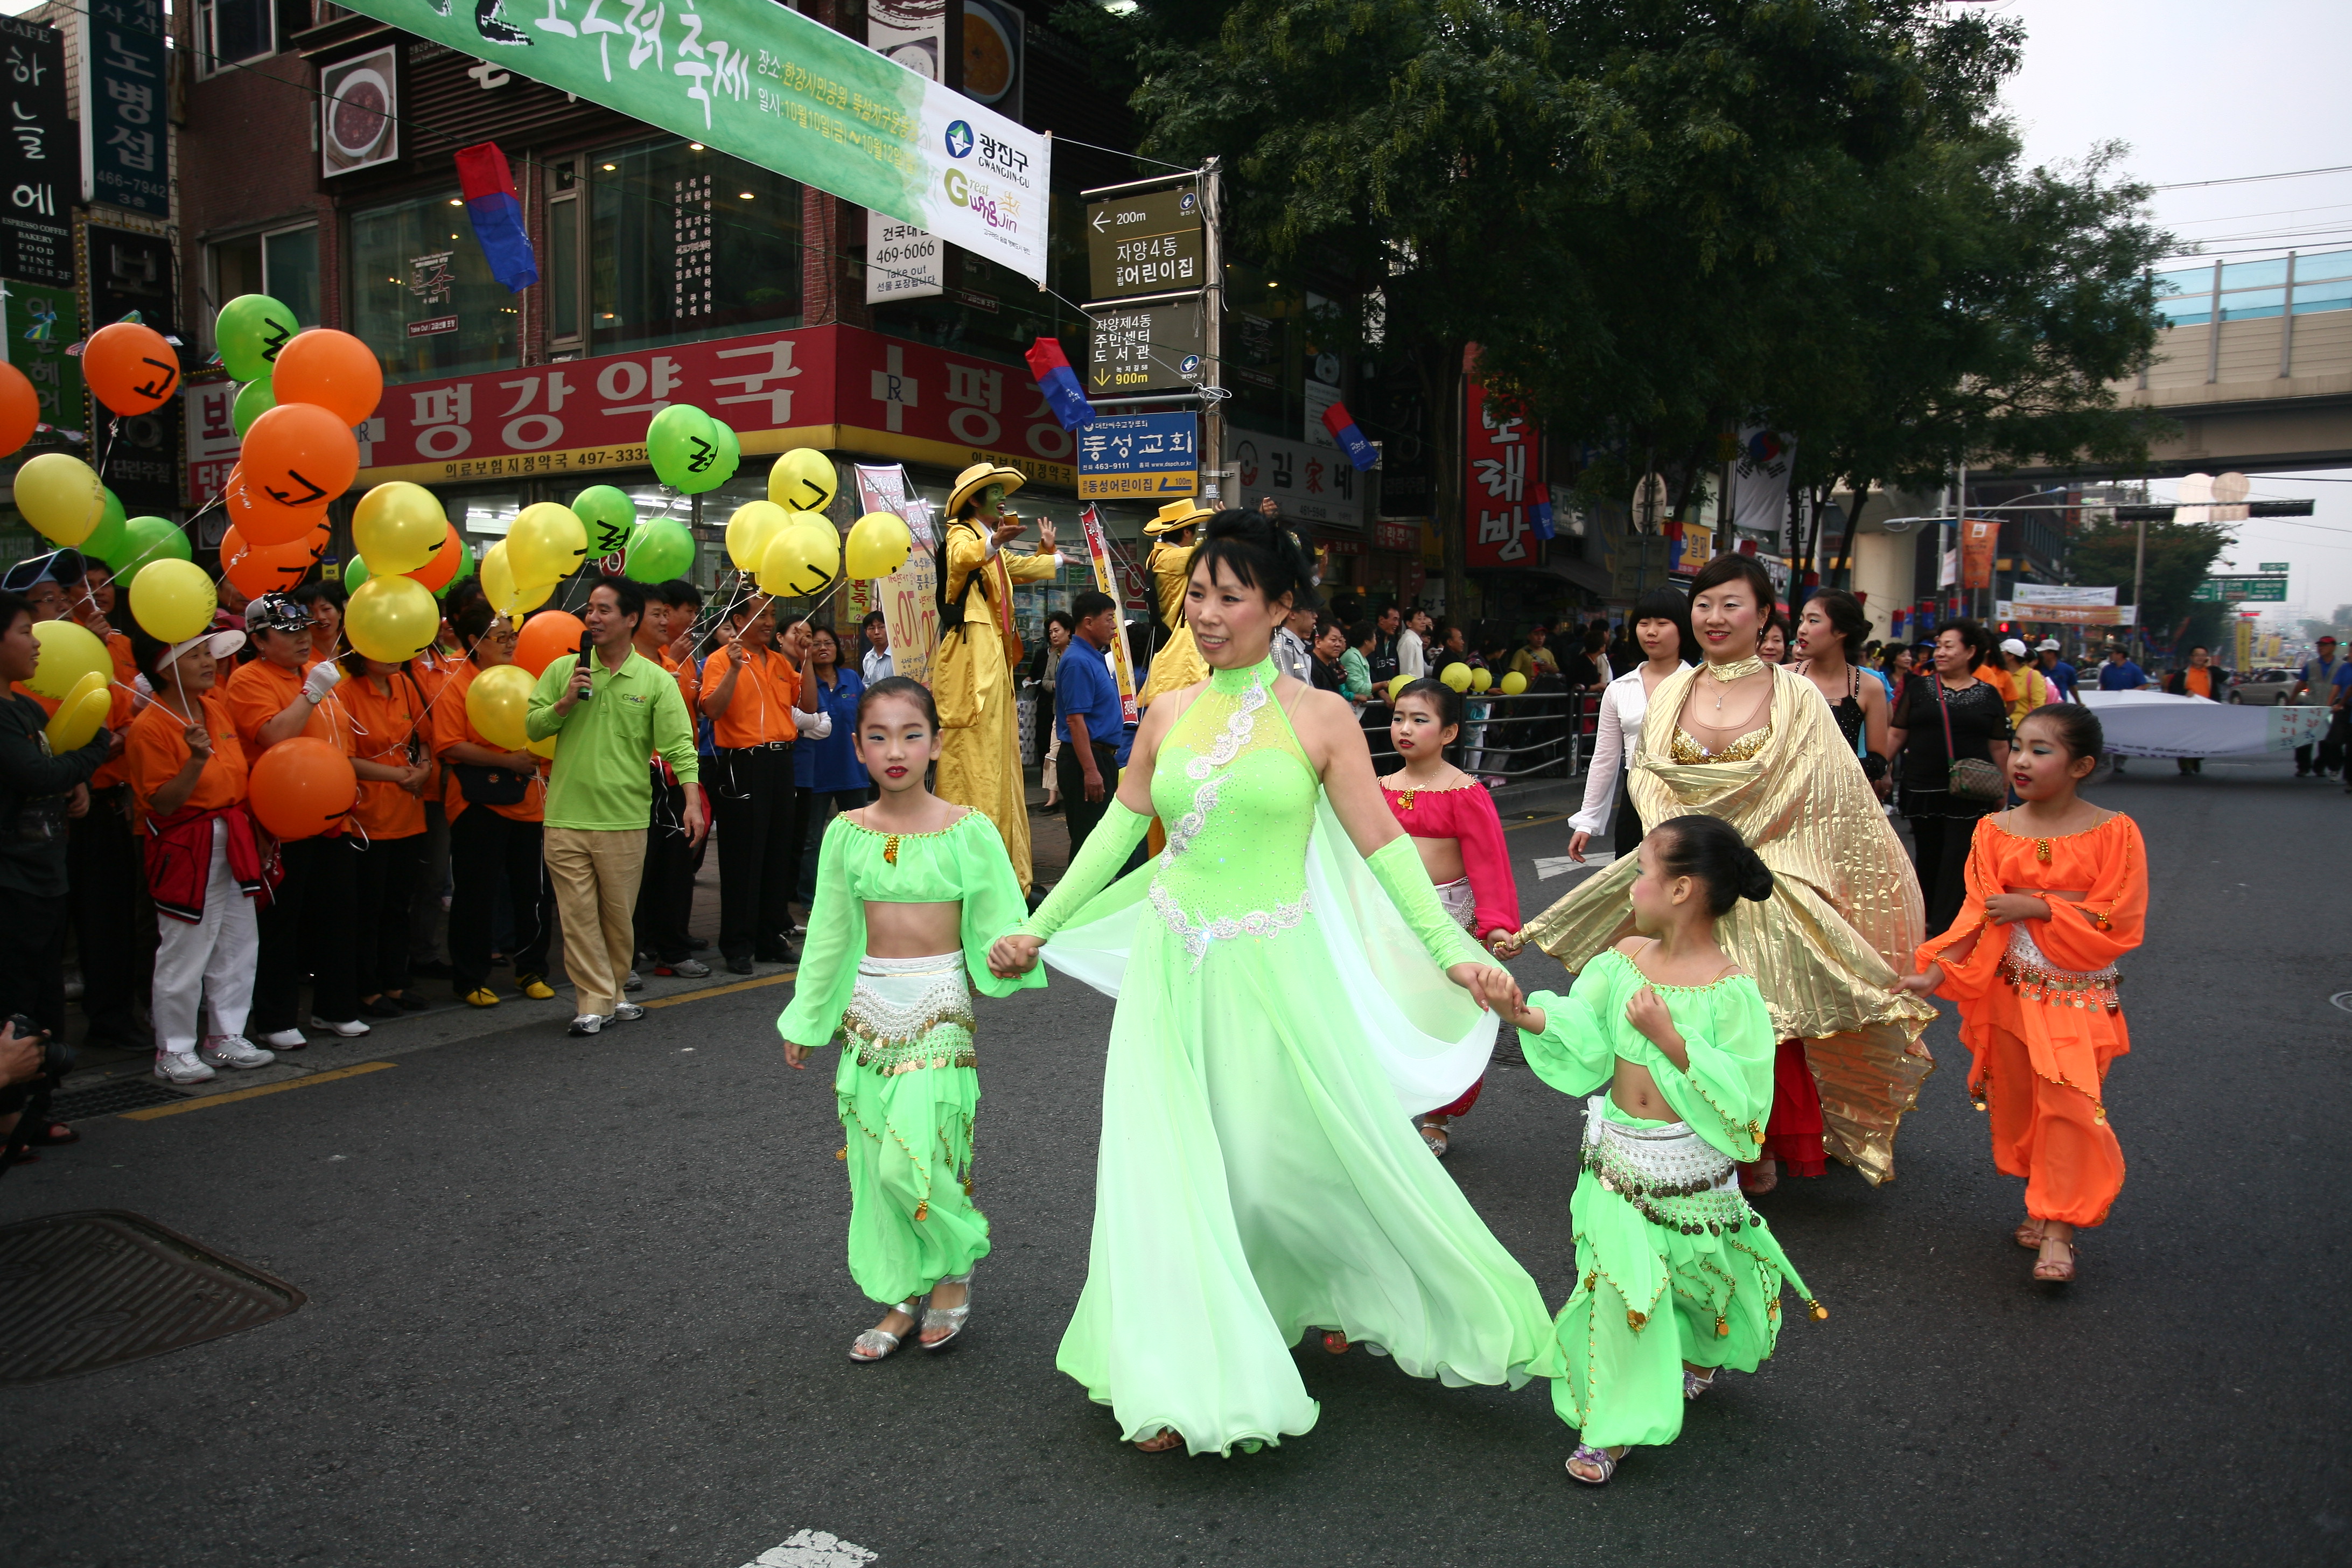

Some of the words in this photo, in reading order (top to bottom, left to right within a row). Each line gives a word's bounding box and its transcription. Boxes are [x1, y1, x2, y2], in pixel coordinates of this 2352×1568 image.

[1, 18, 51, 44] CAFE
[104, 31, 156, 172] 노병섭
[979, 132, 1029, 173] 광진구
[978, 156, 1030, 188] GWANGJIN-GU
[96, 170, 166, 198] 466-7942
[2, 217, 38, 230] ESPRESSO
[39, 223, 69, 236] COFFEE
[1116, 212, 1146, 225] 200m
[18, 231, 54, 244] BAKERY
[883, 225, 929, 242] 건국대
[18, 242, 54, 256] FOOD
[876, 240, 934, 263] 469-6066
[1117, 237, 1177, 262] 자양4동
[18, 254, 54, 267] WINE
[18, 264, 54, 277] BEER
[57, 270, 72, 281] 2F
[886, 269, 908, 279] Take
[911, 265, 926, 275] out
[1124, 257, 1193, 285] 어린이집
[877, 282, 893, 292] 선물
[1096, 314, 1151, 331] 자양제4동
[1094, 329, 1151, 349] 주민센터
[1115, 373, 1148, 385] 900m
[410, 340, 803, 459] 평강약국
